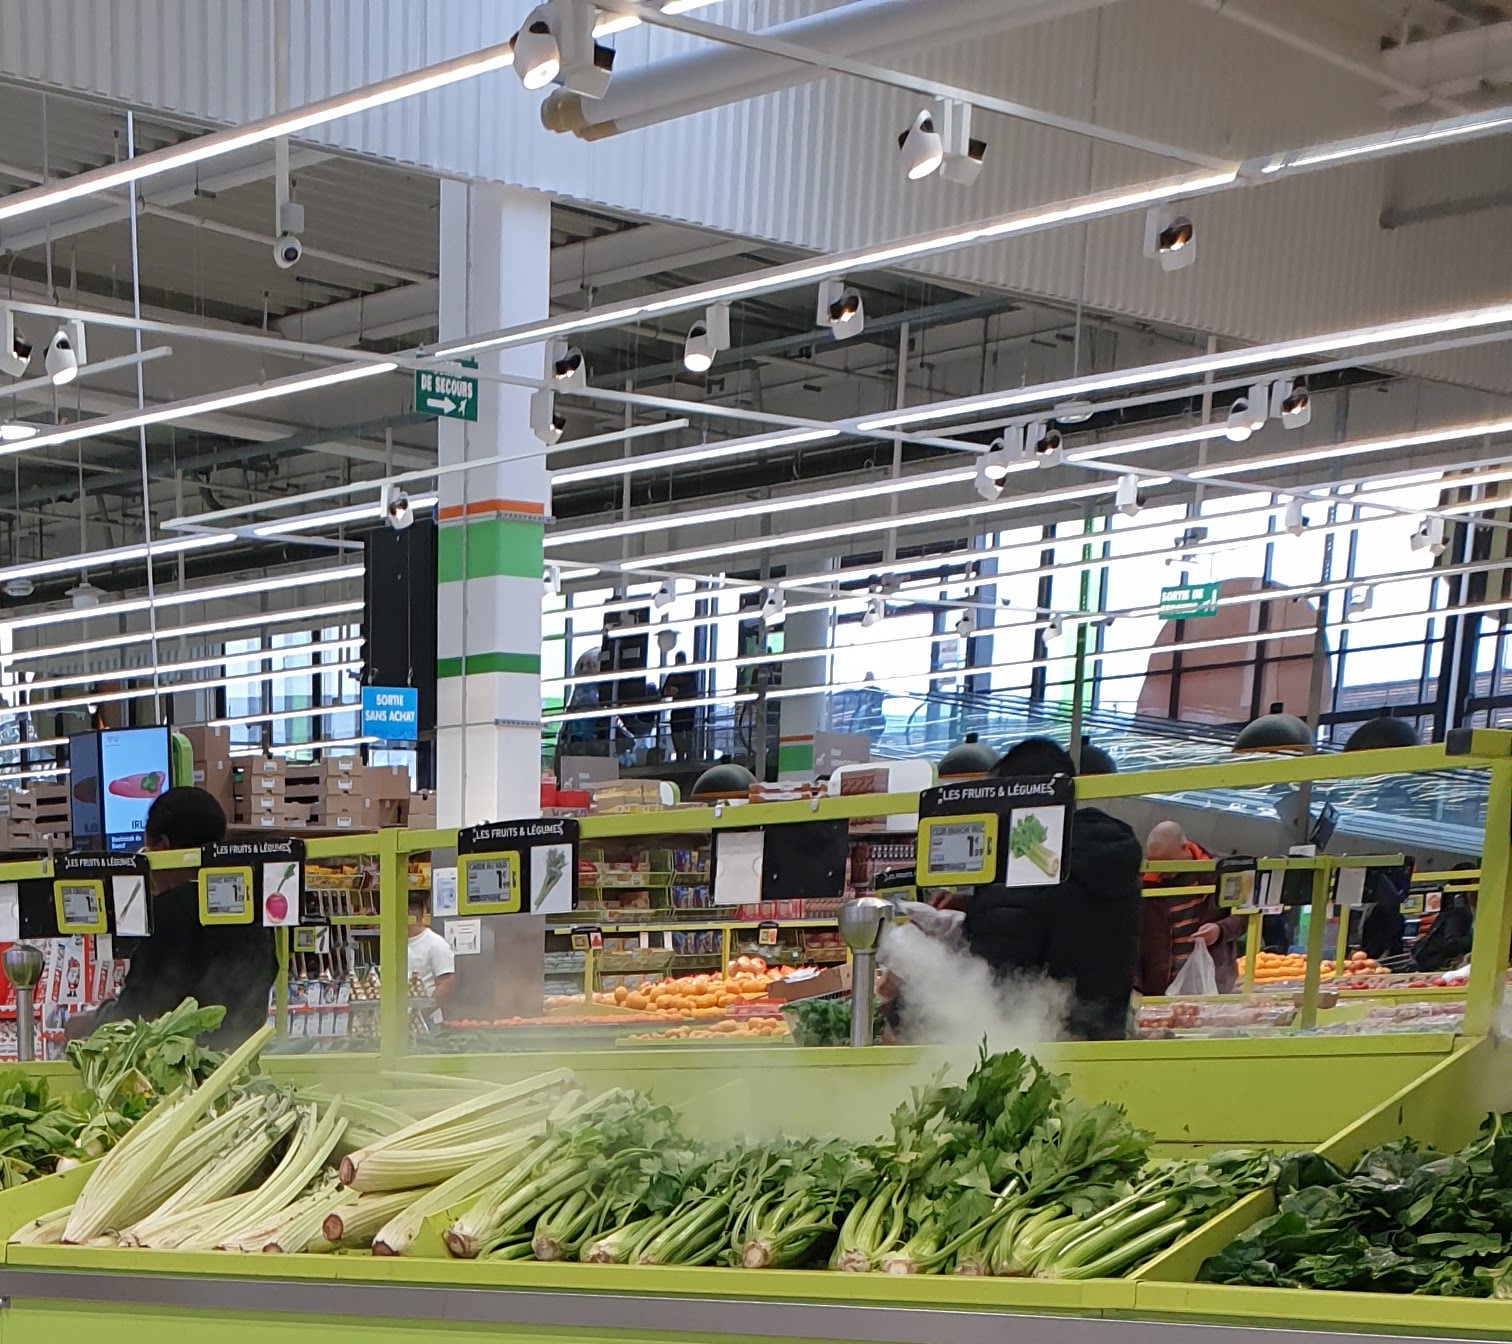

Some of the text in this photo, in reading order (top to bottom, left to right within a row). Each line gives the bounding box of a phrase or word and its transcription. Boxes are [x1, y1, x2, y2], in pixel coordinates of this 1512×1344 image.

[421, 373, 473, 399] DE SECOURS
[376, 694, 405, 706] SORTIE
[365, 710, 416, 722] SANS ACHAT
[943, 782, 1053, 801] LES FRUITS & LÉGUMES
[476, 823, 564, 840] LES FRUITS & LÉGUMES
[216, 841, 291, 855] LES FRUITS & LÉGUMES
[68, 858, 79, 867] LES
[79, 858, 101, 867] FRUITS
[107, 856, 135, 867] LÉGUMES
